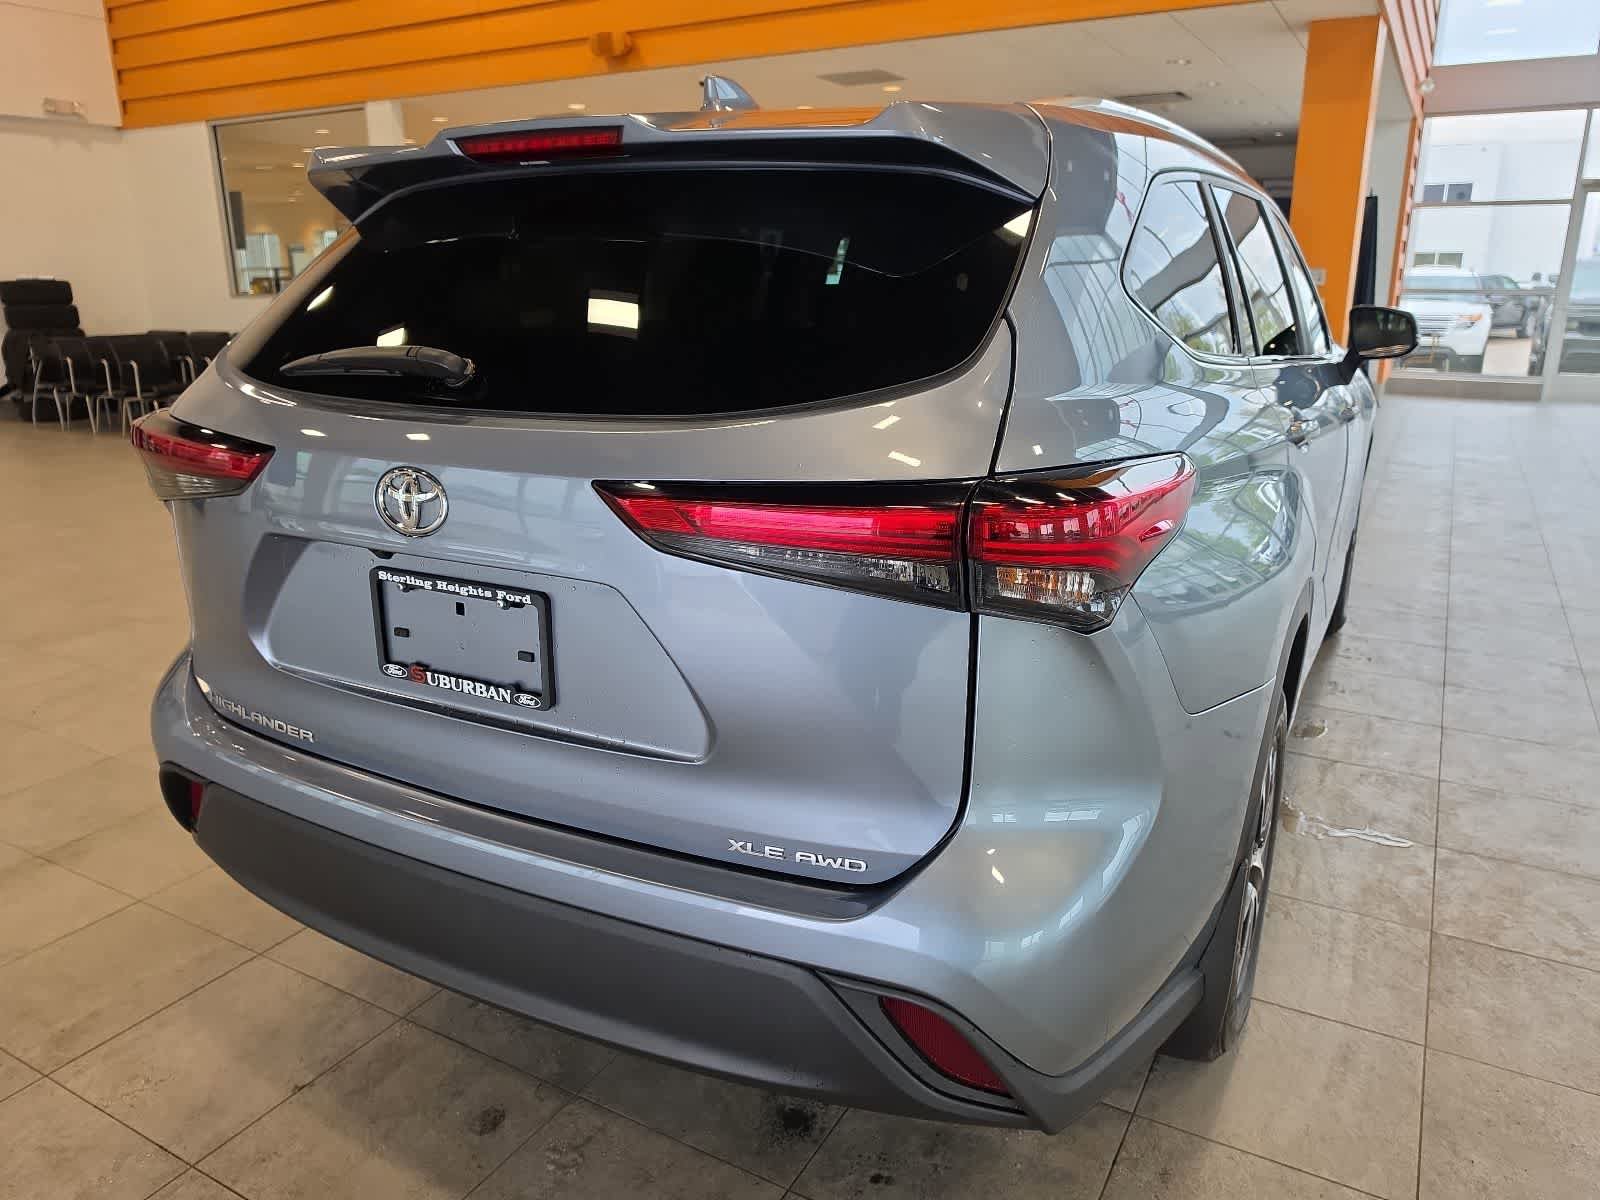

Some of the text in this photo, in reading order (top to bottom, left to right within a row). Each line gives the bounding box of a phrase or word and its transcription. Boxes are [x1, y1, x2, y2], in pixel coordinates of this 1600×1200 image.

[378, 571, 532, 605] Sterling Heights Ford
[386, 665, 404, 677] Ford
[409, 664, 511, 703] SUBURBAN
[209, 692, 314, 743] HIGHLANDER
[517, 695, 537, 707] Ford
[727, 838, 868, 873] XLE AWD
